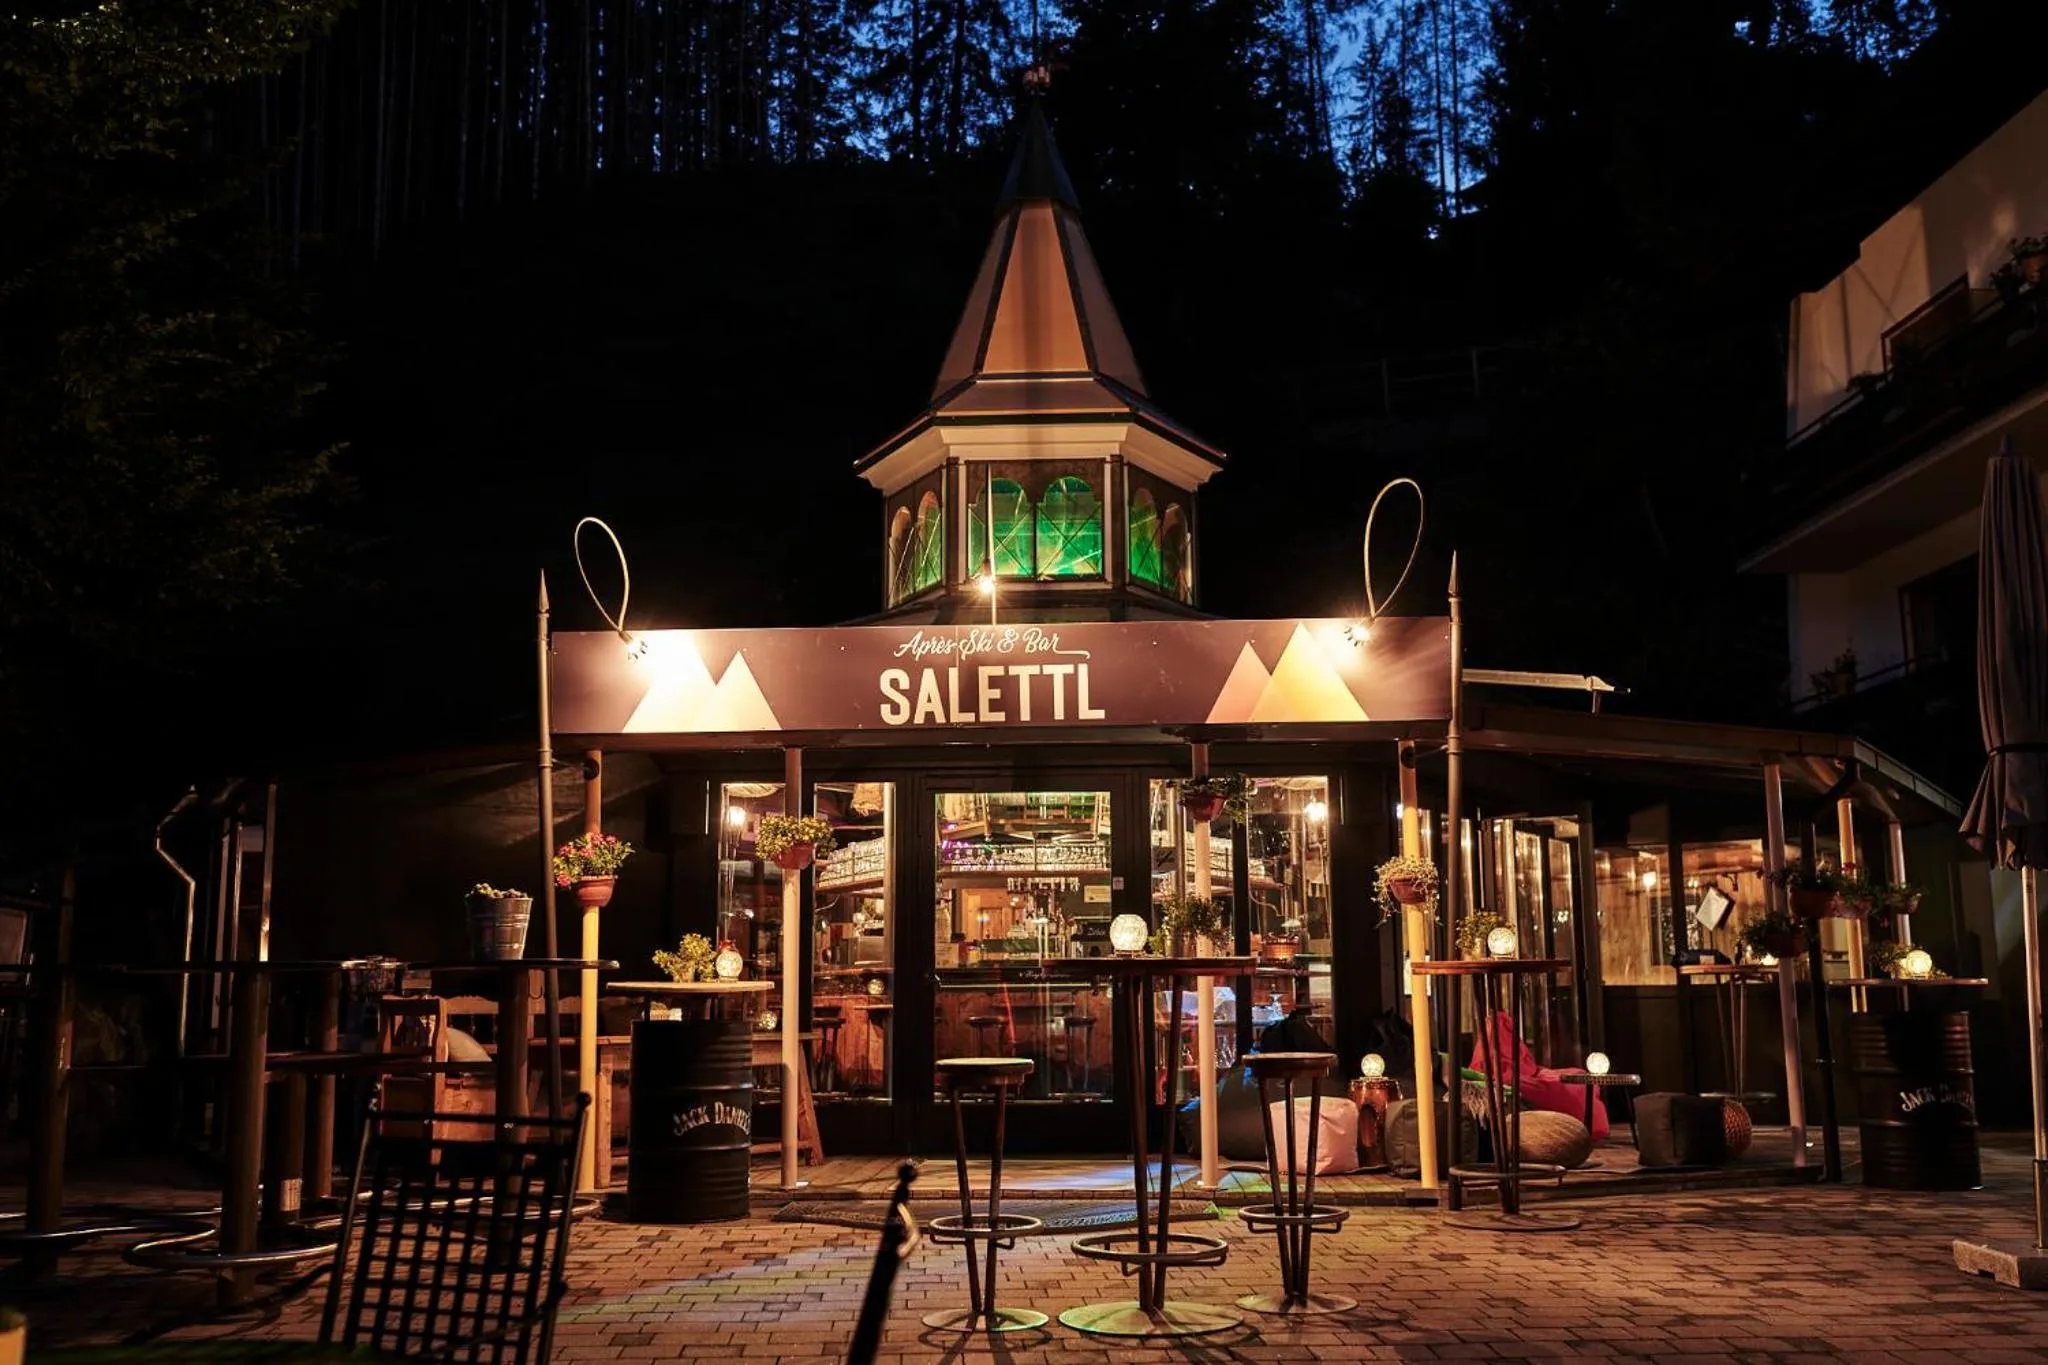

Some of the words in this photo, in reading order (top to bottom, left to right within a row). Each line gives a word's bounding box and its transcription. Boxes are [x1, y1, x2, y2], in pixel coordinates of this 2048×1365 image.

[997, 628, 1019, 653] &
[1023, 627, 1090, 659] Bar
[880, 663, 1105, 725] SALETTL
